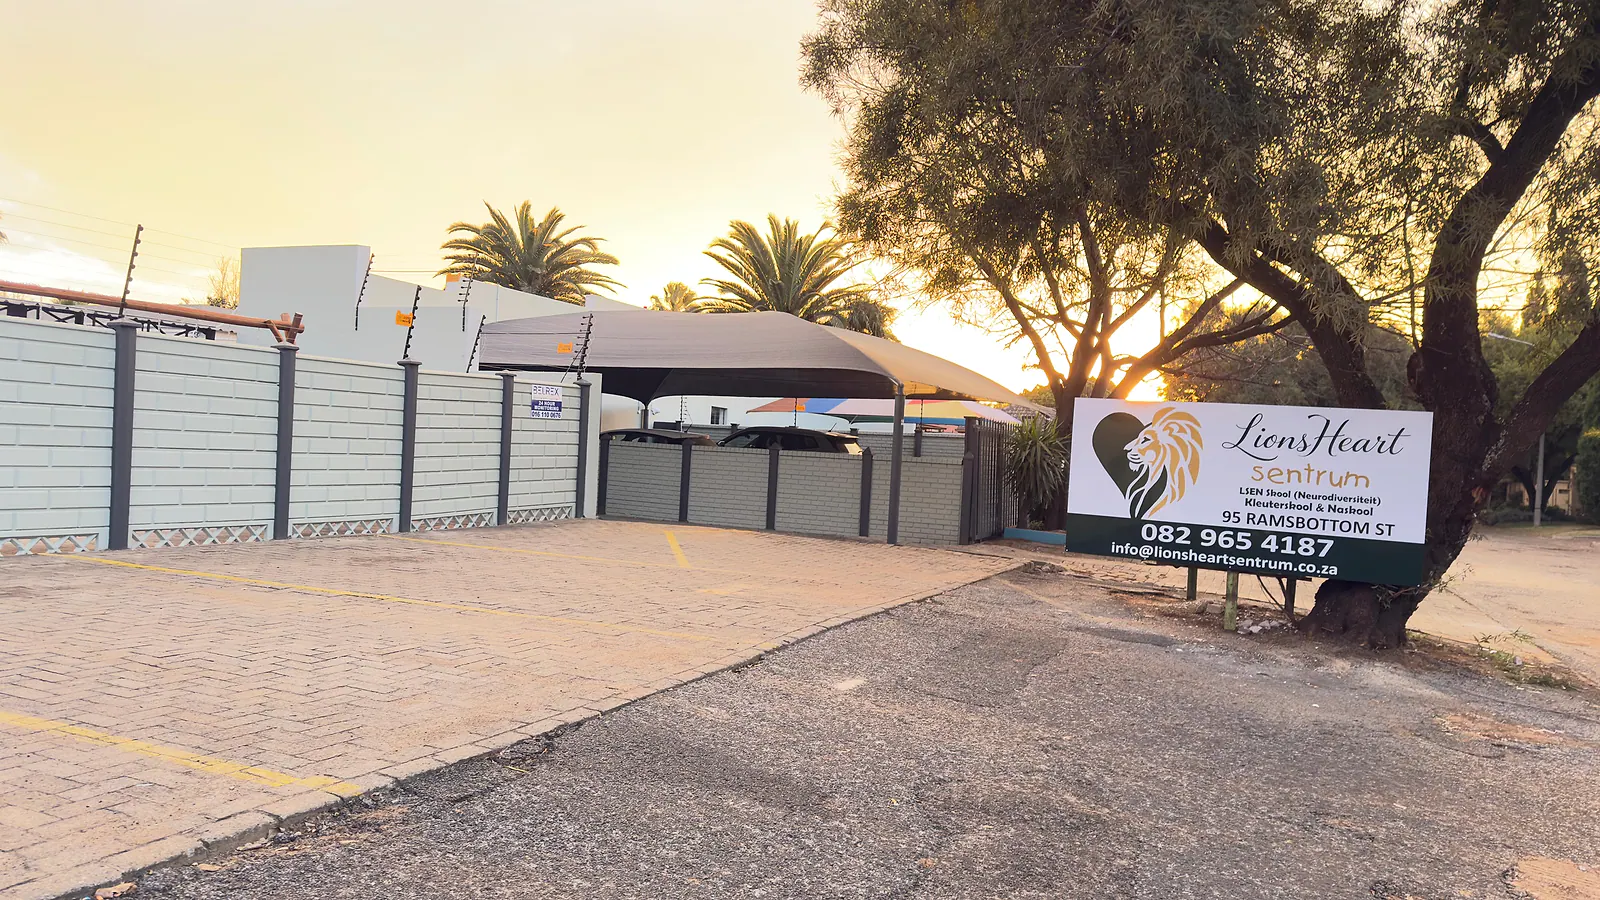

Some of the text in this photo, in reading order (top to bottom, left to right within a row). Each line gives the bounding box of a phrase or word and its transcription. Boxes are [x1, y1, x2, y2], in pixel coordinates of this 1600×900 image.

[533, 386, 559, 396] BELREX
[1221, 412, 1411, 461] LionsHeart
[1251, 463, 1370, 489] sentrum
[1239, 487, 1382, 507] LSEN Skool (Neurodiversiteit)
[1244, 497, 1374, 517] Kleuterskool & Naskool
[1222, 510, 1396, 537] 95 RAMSBOTTOM ST
[1141, 523, 1335, 558] 082 965 4187
[1111, 541, 1339, 576] info@lionsheartsentrum.co.za
